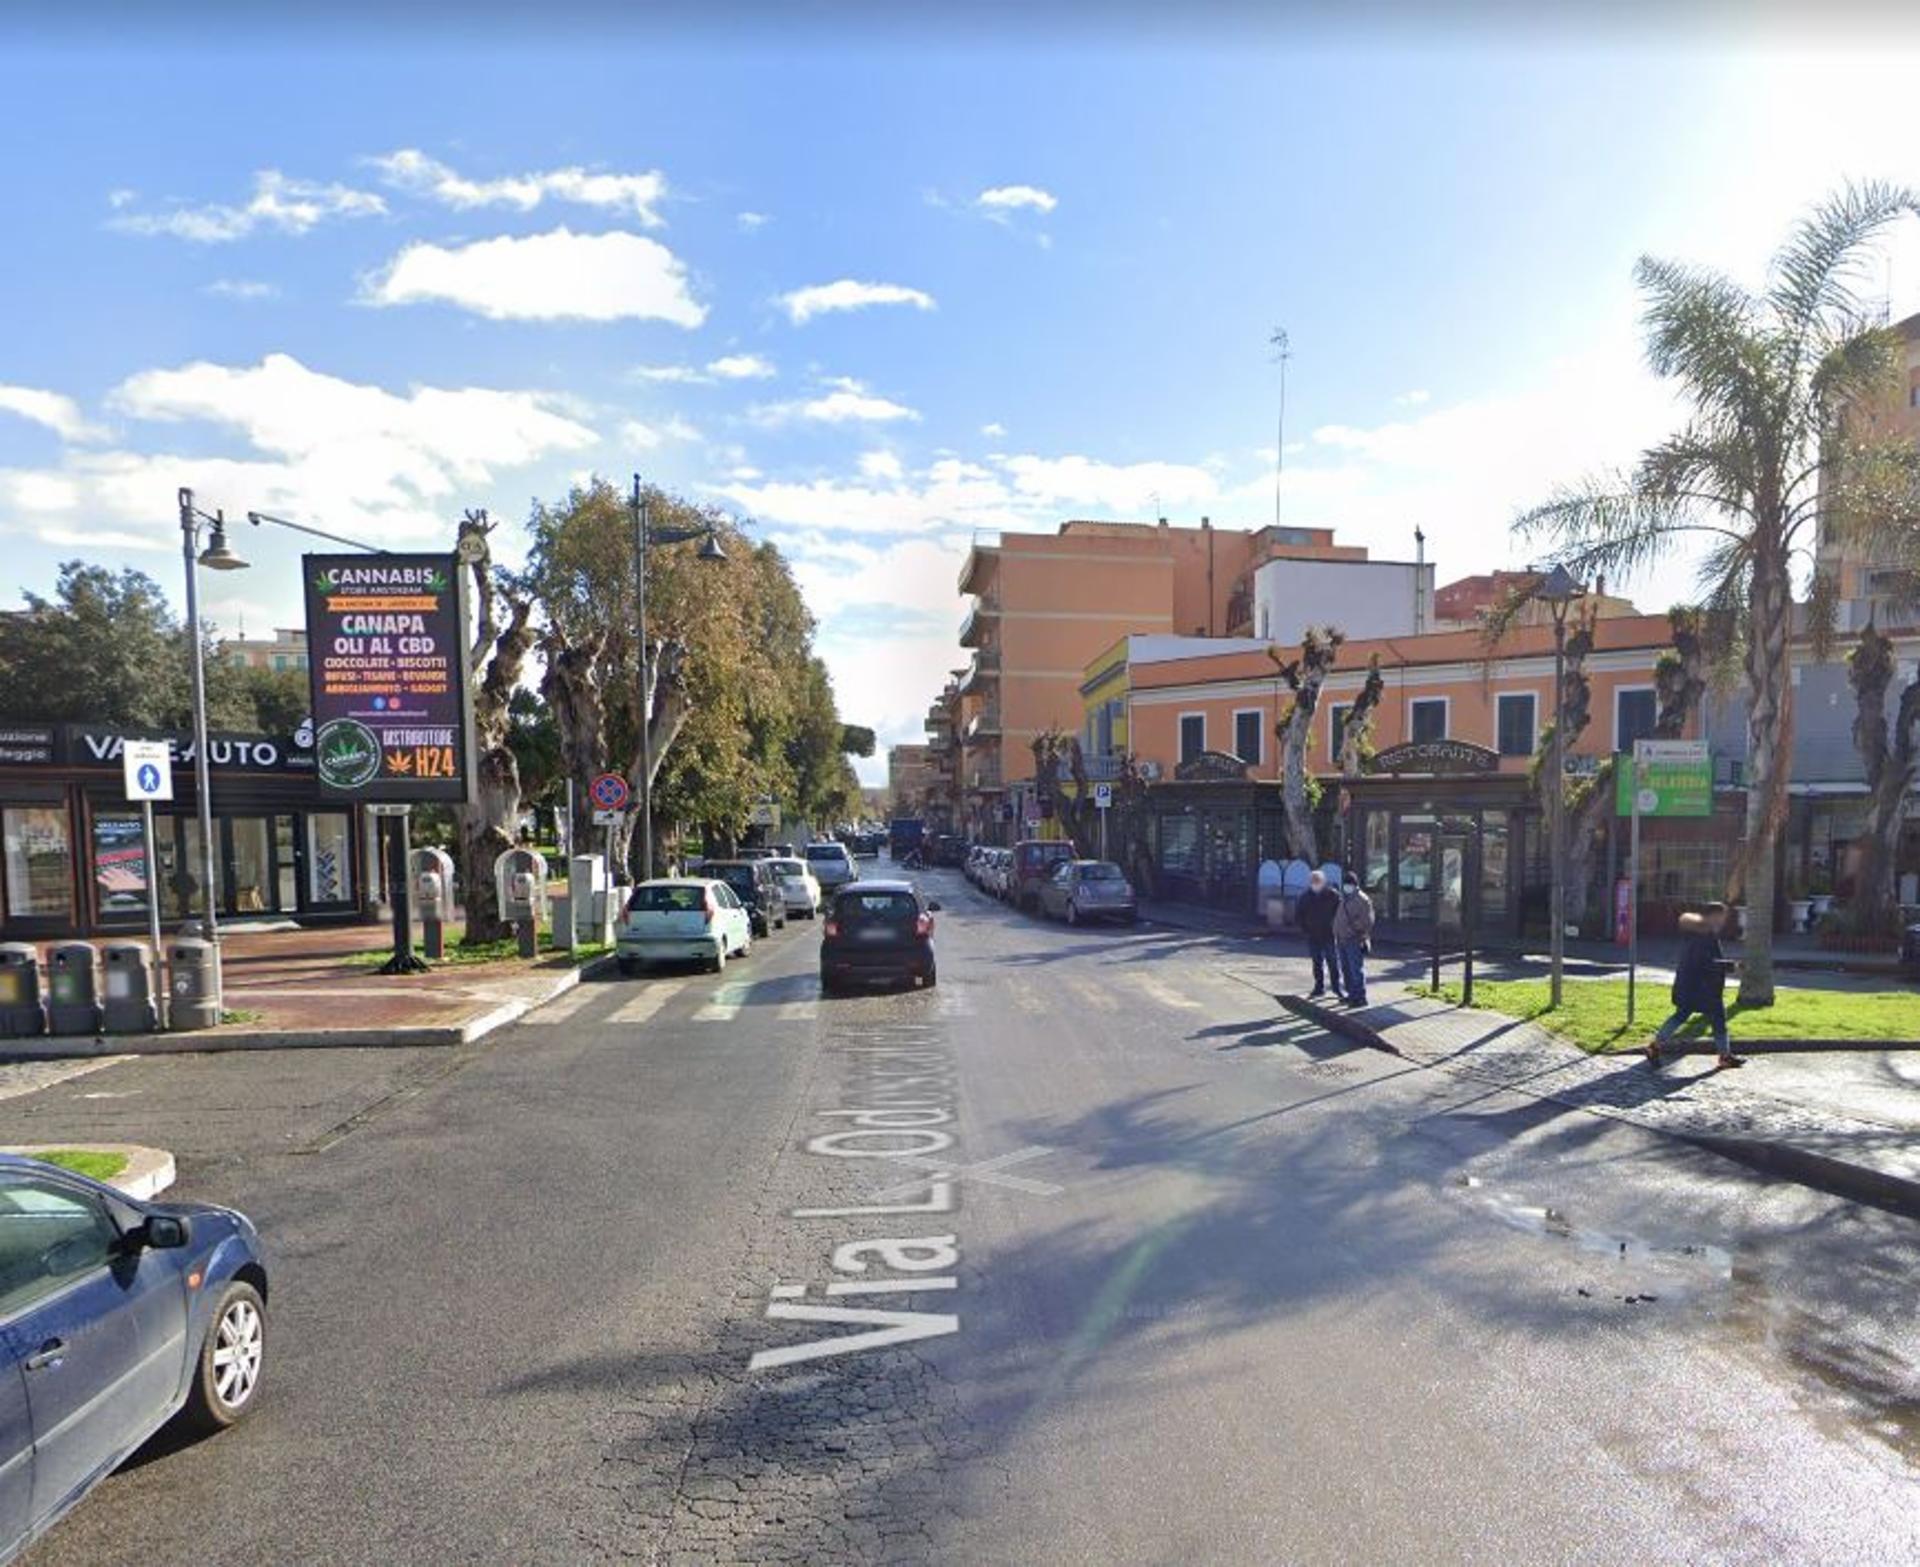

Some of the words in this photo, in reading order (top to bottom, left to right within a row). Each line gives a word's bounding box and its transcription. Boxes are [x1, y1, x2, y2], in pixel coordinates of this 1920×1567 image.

[328, 567, 434, 585] CANNABIS
[341, 614, 425, 634] CANAPA
[334, 637, 365, 654] OLI
[370, 637, 392, 654] AL
[398, 637, 435, 654] CBD
[324, 657, 389, 668] CIOCCOLATE
[397, 656, 447, 668] BISCOTTI
[383, 728, 454, 747] DISTRIBUTORE
[85, 734, 277, 766] VAEAUTO
[415, 747, 456, 777] H24
[748, 1233, 959, 1371] Via
